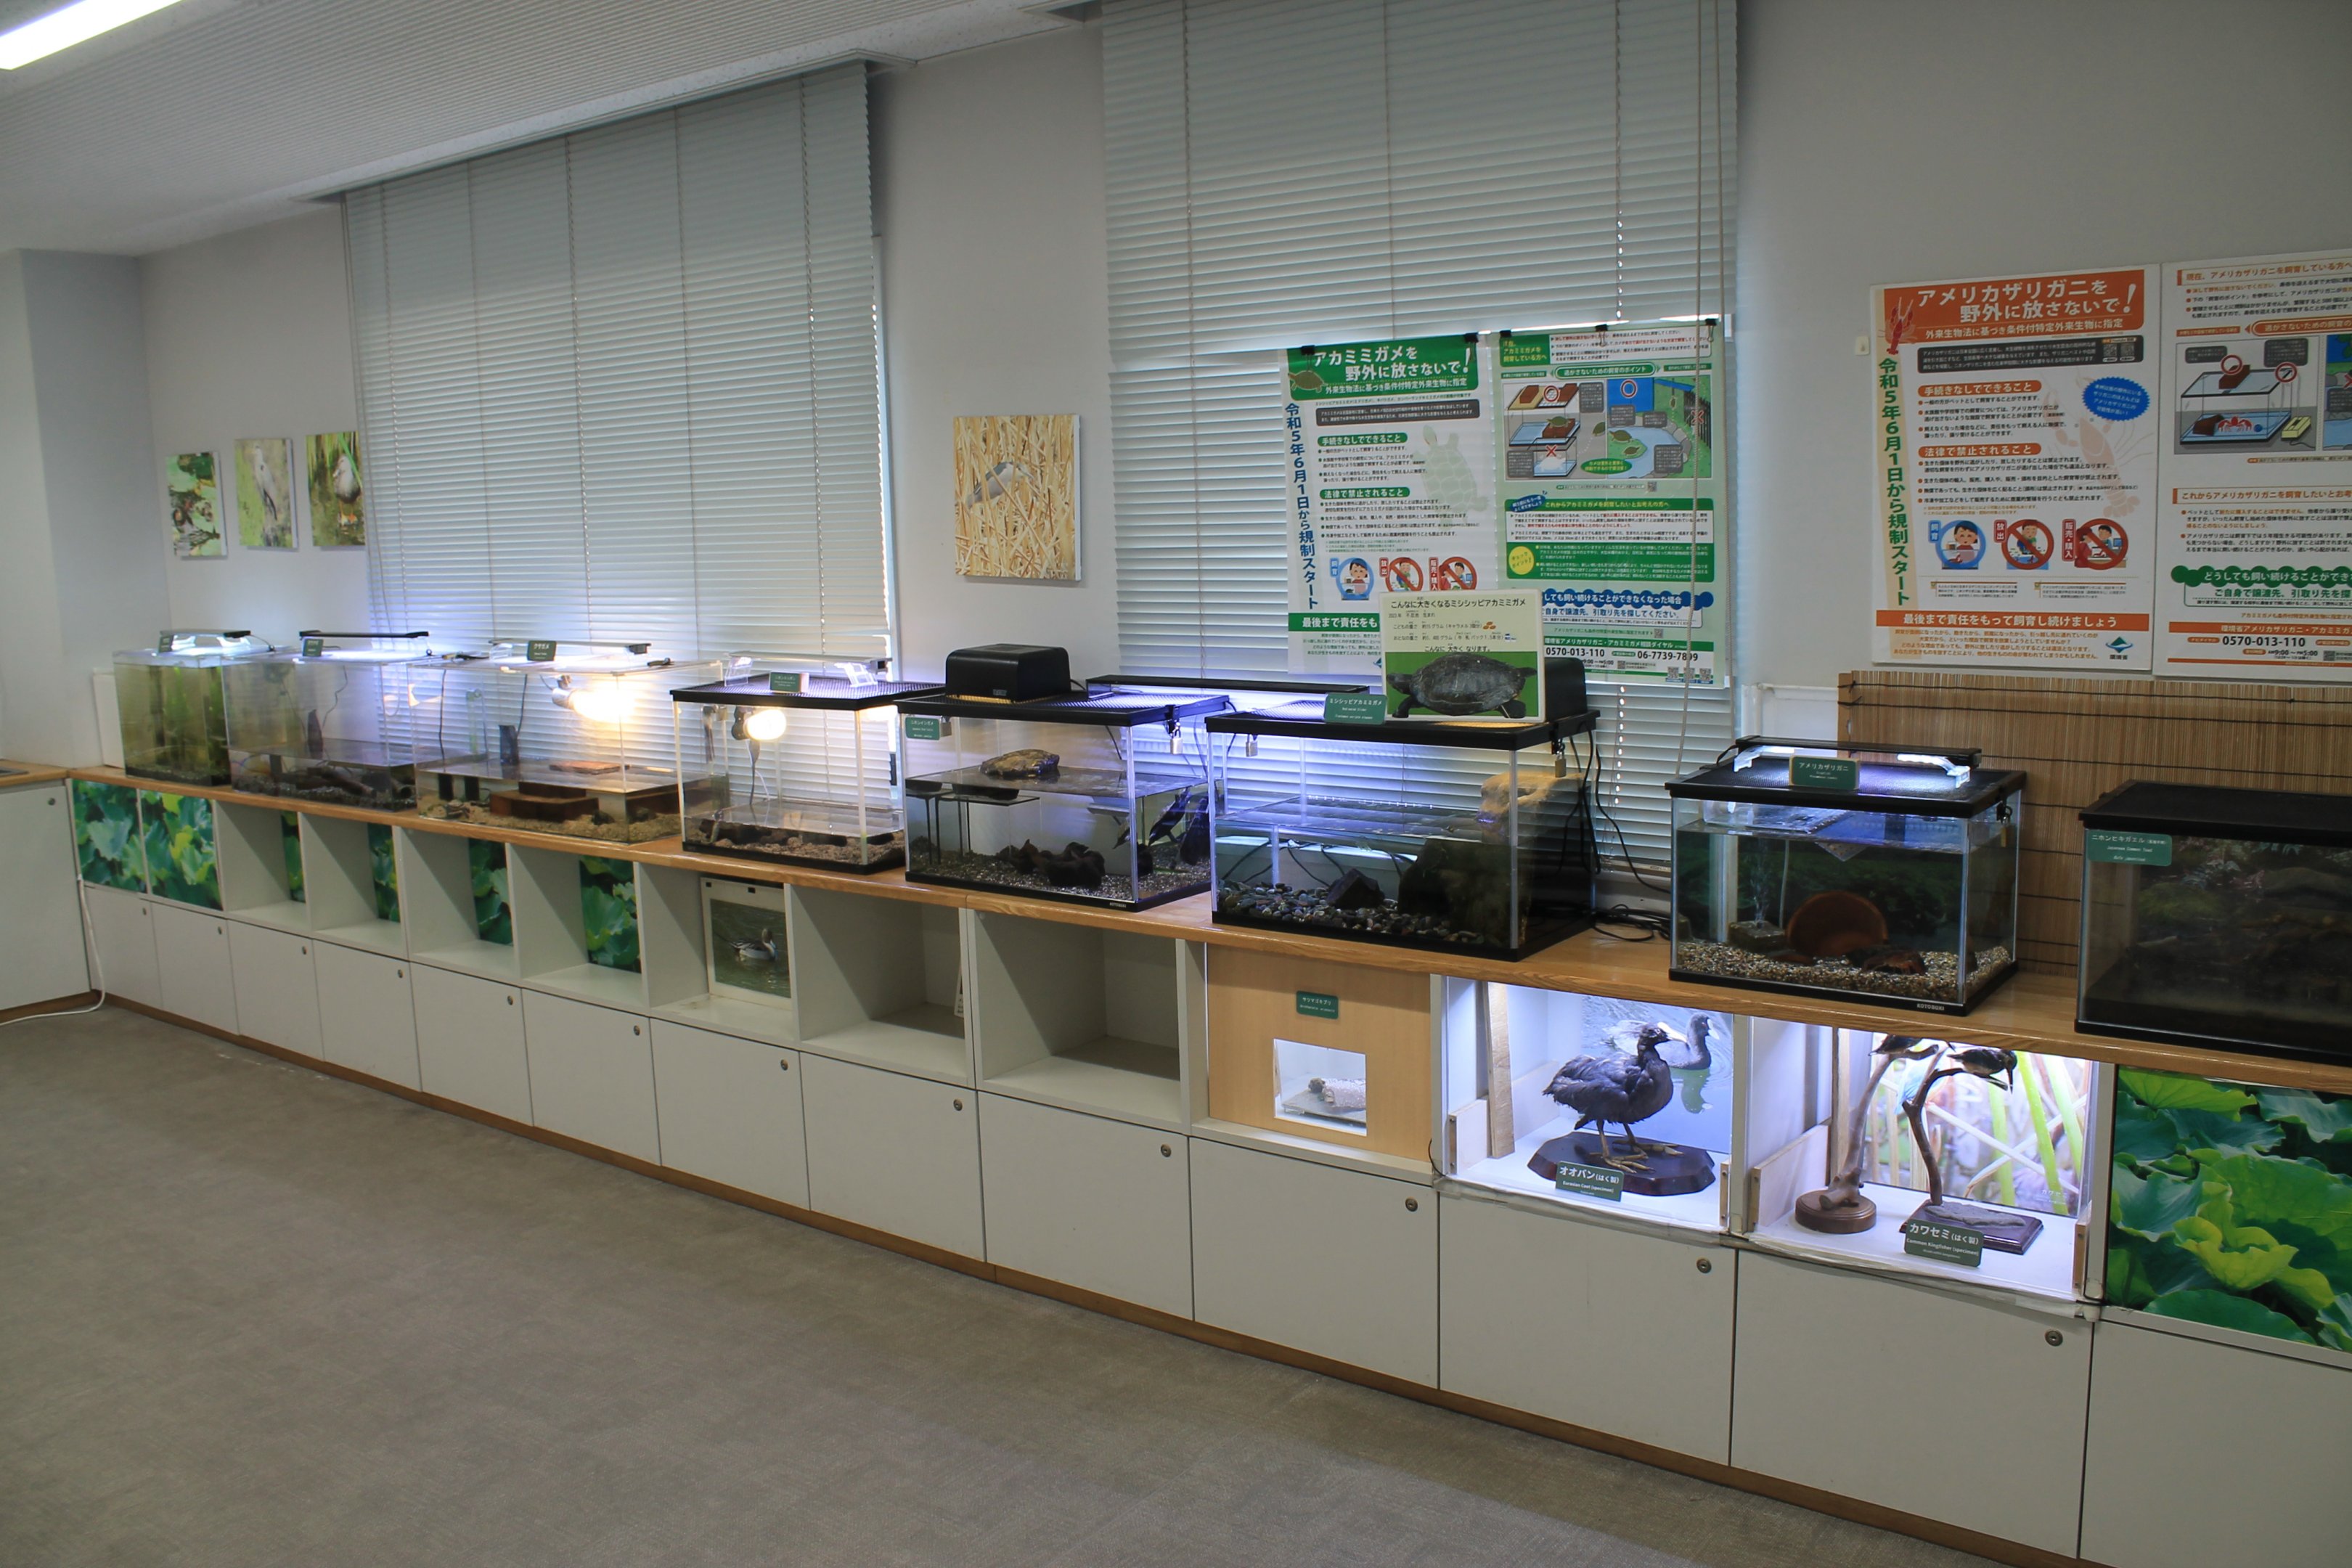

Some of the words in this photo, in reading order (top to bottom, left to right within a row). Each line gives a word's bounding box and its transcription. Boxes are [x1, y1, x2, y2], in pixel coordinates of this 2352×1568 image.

[2186, 262, 2352, 281] 現在、アメリカザリガニを飼育している方へ
[1918, 279, 2107, 307] アメリカザリガニを
[1925, 319, 2123, 339] 外来生物法に基づき条件付特定外来生物に指定
[1314, 346, 1418, 367] アカミミガメを
[1326, 377, 1467, 394] 外来生物法に基づき条件付特定外来生物に指定
[1924, 382, 2032, 396] 手続きなしでできること
[1321, 434, 1401, 446] 手続きなしでできること
[1924, 445, 2032, 457] 法律で禁止されること
[1879, 358, 1909, 605] 令和5年6月1日から規制スタート
[1324, 489, 1404, 498] 法律で禁止されること
[2182, 490, 2352, 499] これからアメリカザリガニを飼育したいとお考
[1285, 403, 1318, 609] 令和5年6月1日から規制スタート
[1931, 523, 1939, 541] 飼育
[1996, 522, 2005, 541] 放出
[2065, 520, 2074, 560] 販売・購入
[1391, 598, 1526, 608] こんなに大きくなるミシシッピアカミミガメ
[1302, 617, 1378, 629] 最後まで責任をも
[1903, 612, 2118, 628] 最後まで責任をもって飼育し続けましょう
[2221, 624, 2352, 635] 環境省アメリカザリガニ・アカミミガ
[2223, 635, 2306, 648] 0570-013-110
[1546, 647, 1605, 657] 0570-013-110
[1799, 762, 1848, 771] アメリカザリガニ
[1928, 1241, 1952, 1250] Kingfisher
